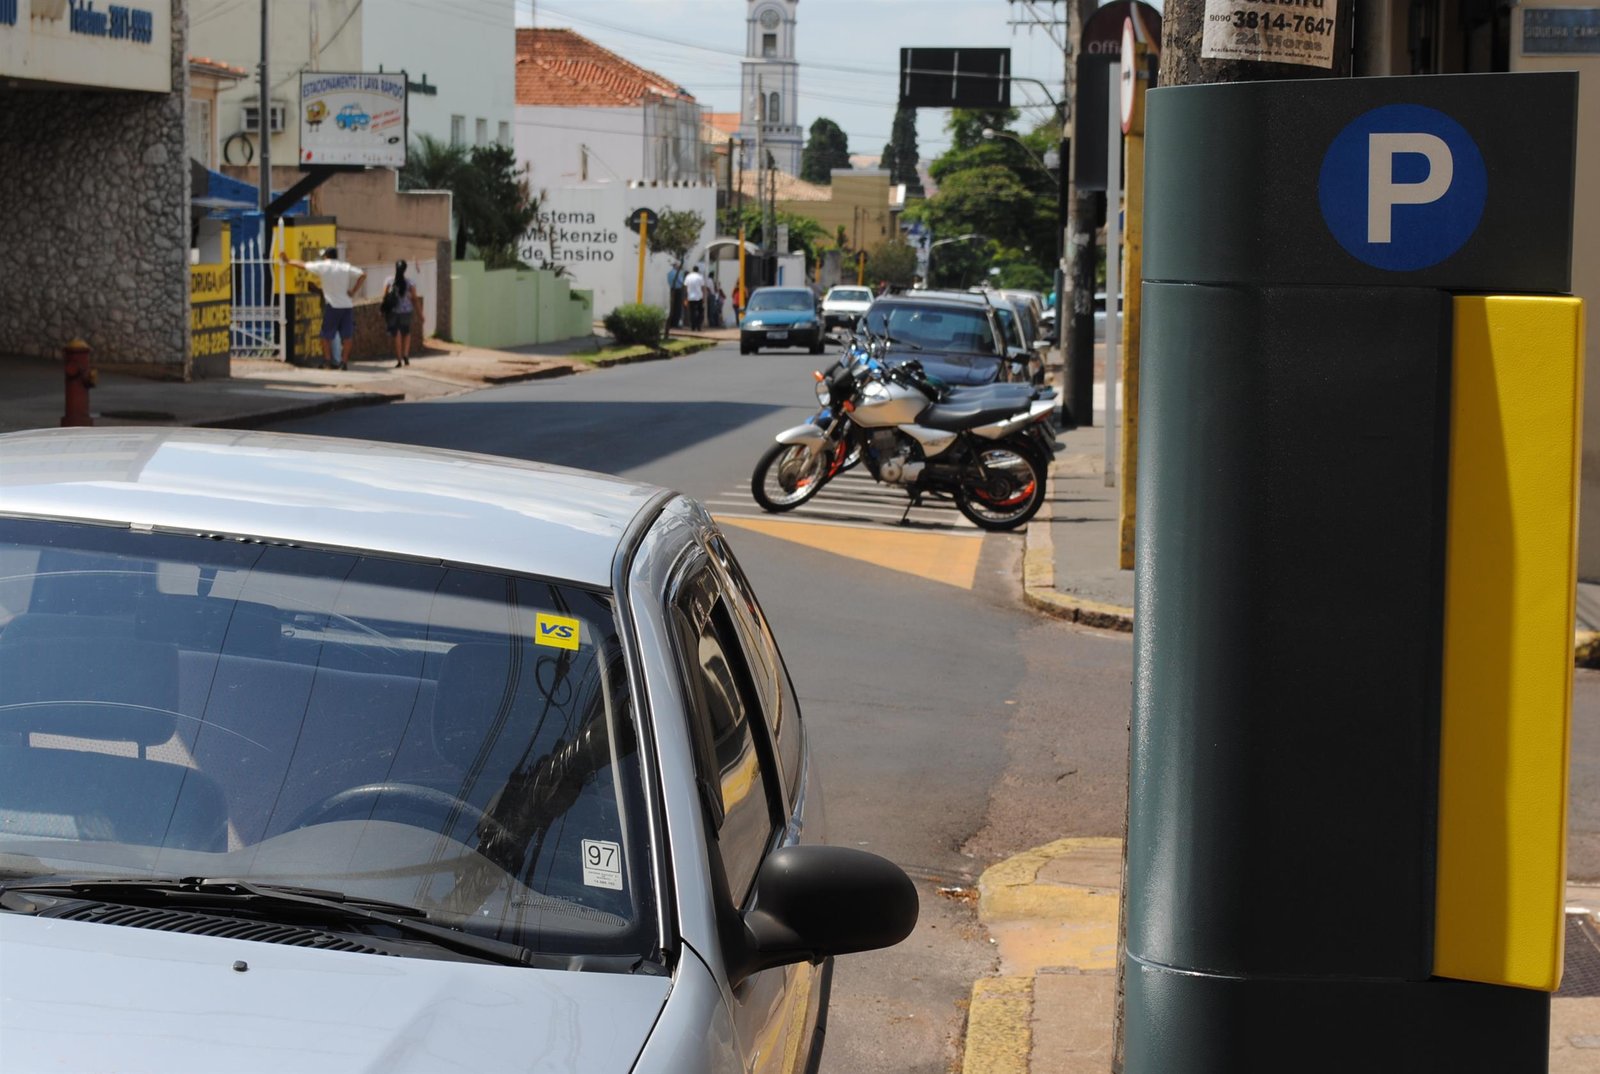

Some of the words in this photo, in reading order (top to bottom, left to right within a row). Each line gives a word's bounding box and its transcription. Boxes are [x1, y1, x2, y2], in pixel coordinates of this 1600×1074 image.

[1209, 14, 1231, 22] 9090
[1233, 10, 1334, 36] 3814-7647
[1234, 32, 1260, 46] 24
[1266, 34, 1323, 52] Horas
[1367, 132, 1454, 243] P
[534, 210, 596, 225] istema
[522, 245, 543, 260] de
[551, 246, 614, 262] Ensino
[540, 622, 574, 638] VS
[588, 845, 615, 867] 97
